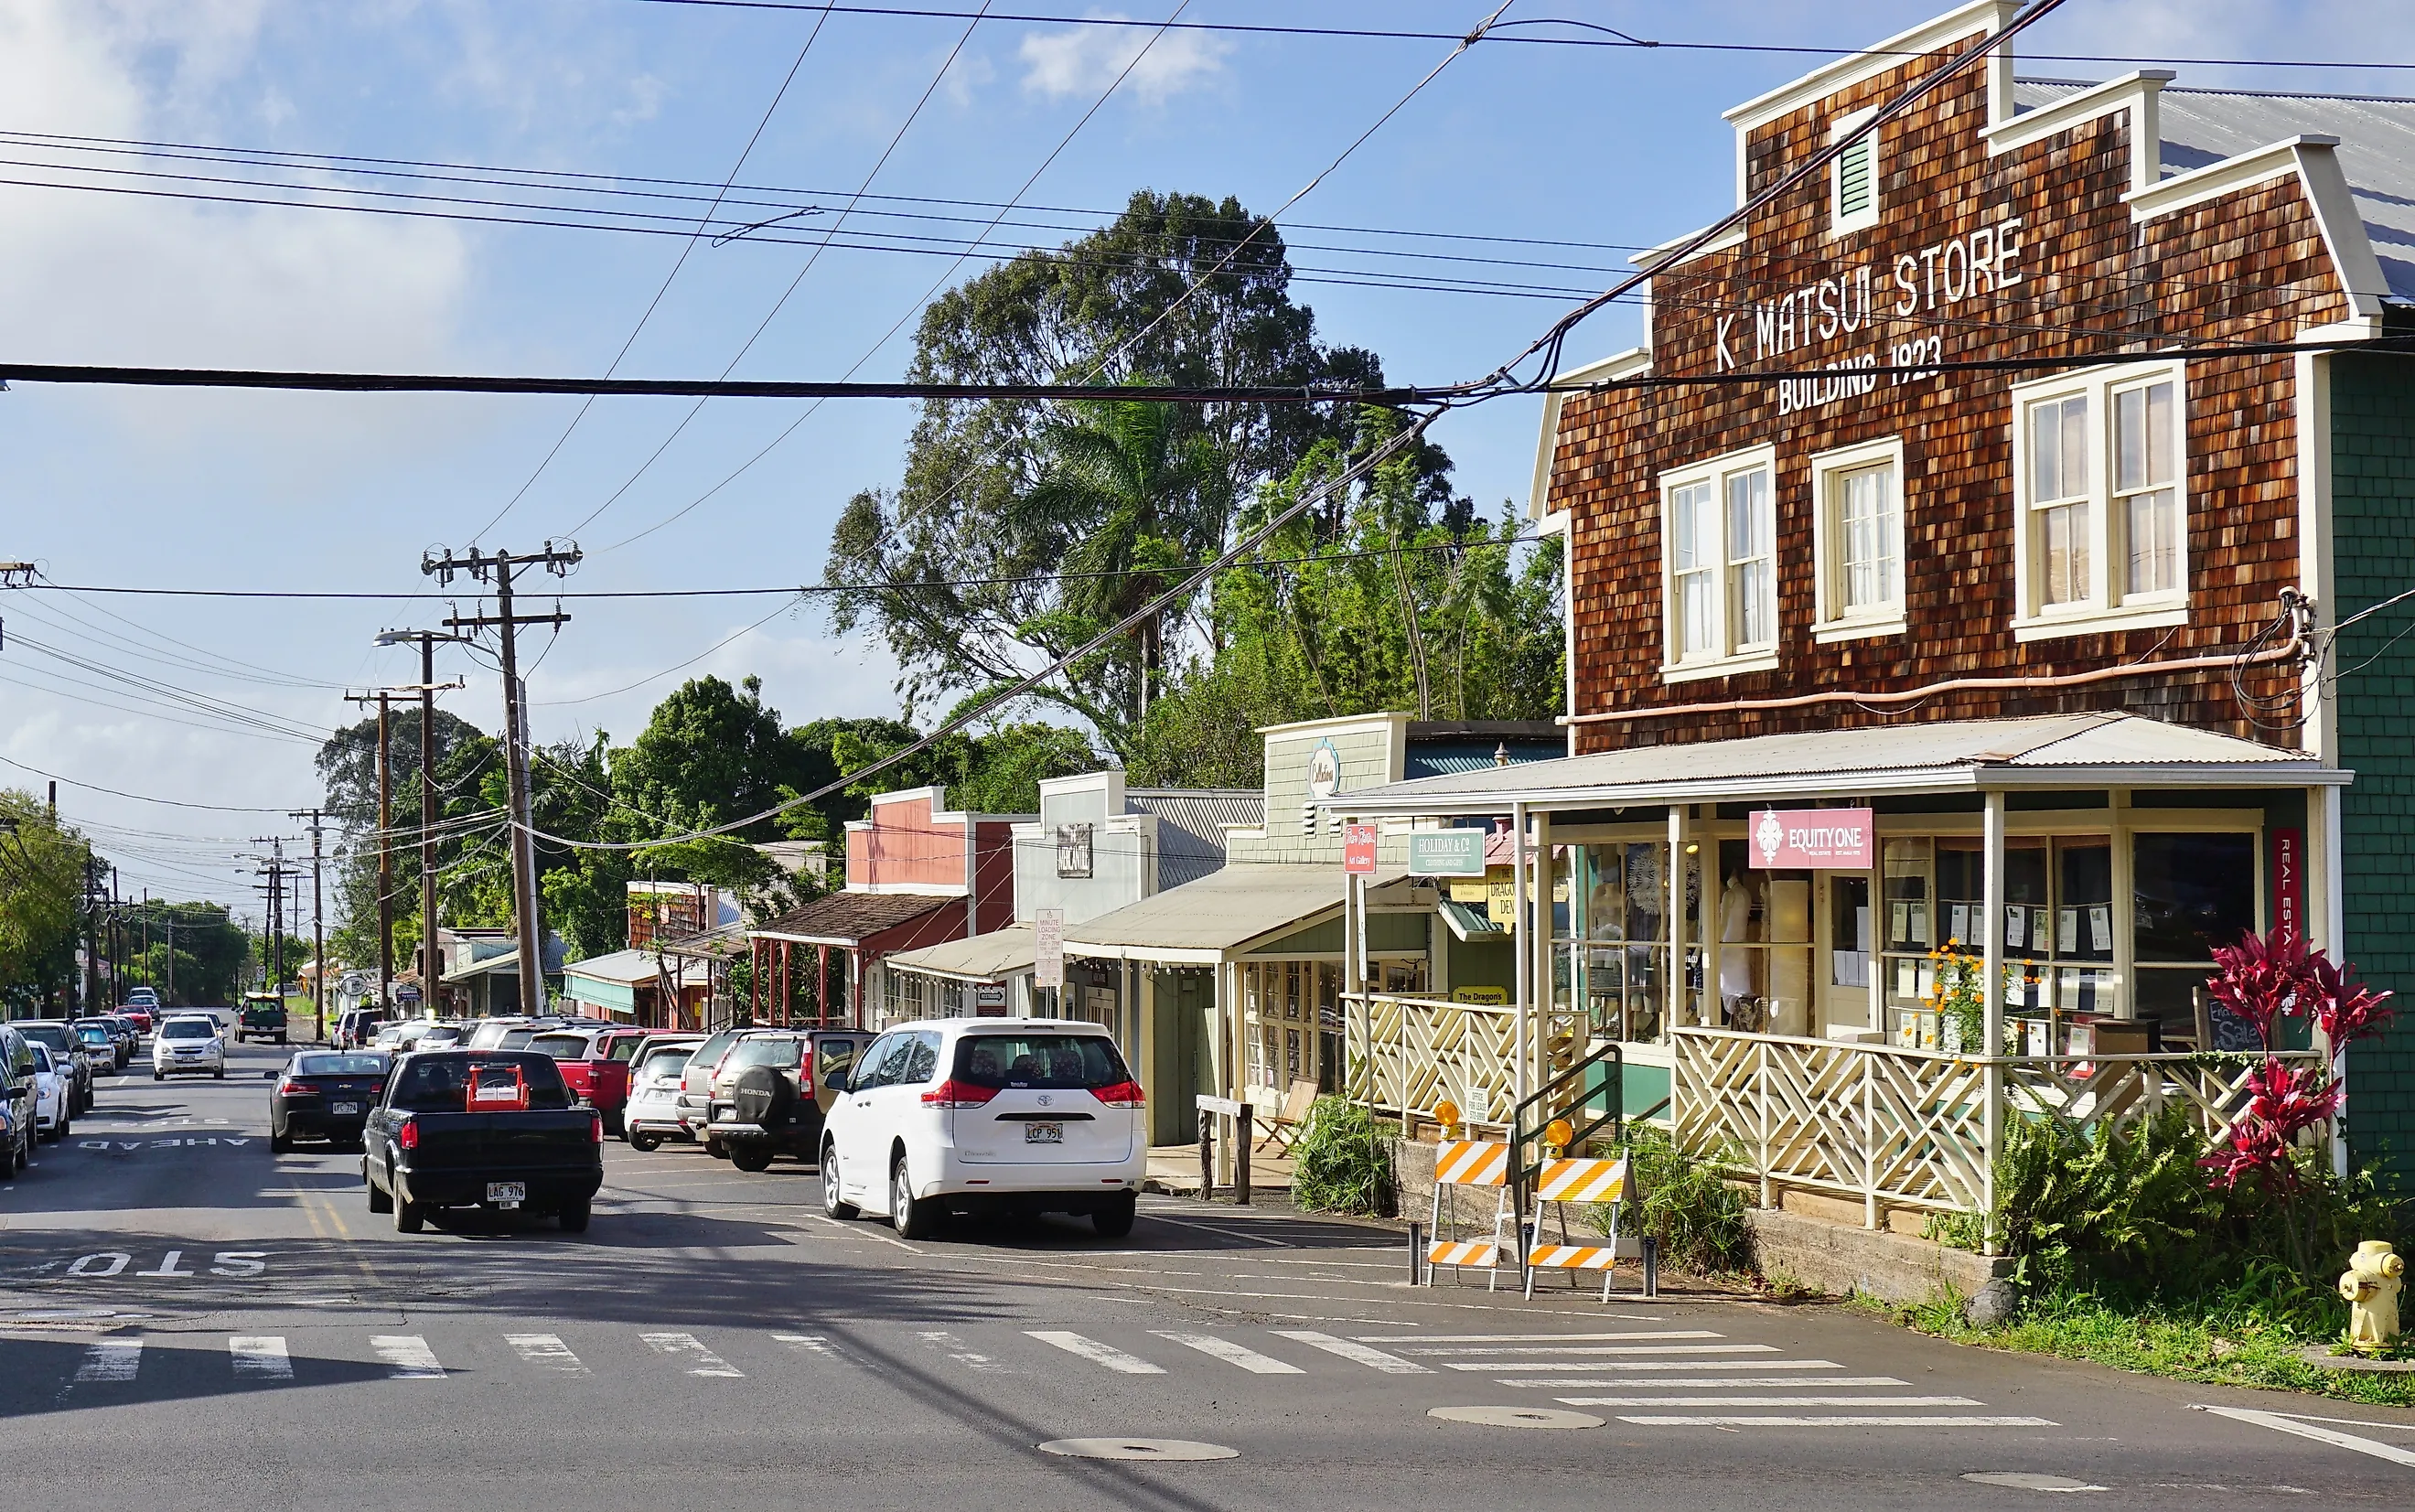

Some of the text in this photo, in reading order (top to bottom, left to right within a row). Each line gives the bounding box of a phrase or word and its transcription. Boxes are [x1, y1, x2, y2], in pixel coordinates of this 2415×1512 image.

[1716, 217, 2023, 373] K MATSUI STORE
[1778, 335, 1942, 416] BUILDING 1923
[1418, 838, 1454, 853] HOLIDAY
[1454, 839, 1460, 853] &
[1788, 827, 1864, 853] EQUITY ONE
[1058, 845, 1089, 871] MERCANTILE
[1356, 855, 1371, 866] Gallery
[1501, 868, 1510, 878] THE
[2281, 839, 2292, 960] REAL ESTA
[1500, 899, 1515, 915] DEN
[1458, 992, 1502, 1002] The Dragon's
[2218, 1021, 2260, 1050] Sale
[740, 1088, 772, 1097] HONDA
[1472, 1092, 1484, 1102] OFFICE
[1476, 1102, 1487, 1111] LEASE
[1027, 1128, 1060, 1139] LCP 951
[78, 1138, 251, 1151] AHEAD
[488, 1185, 524, 1197] LAG 976
